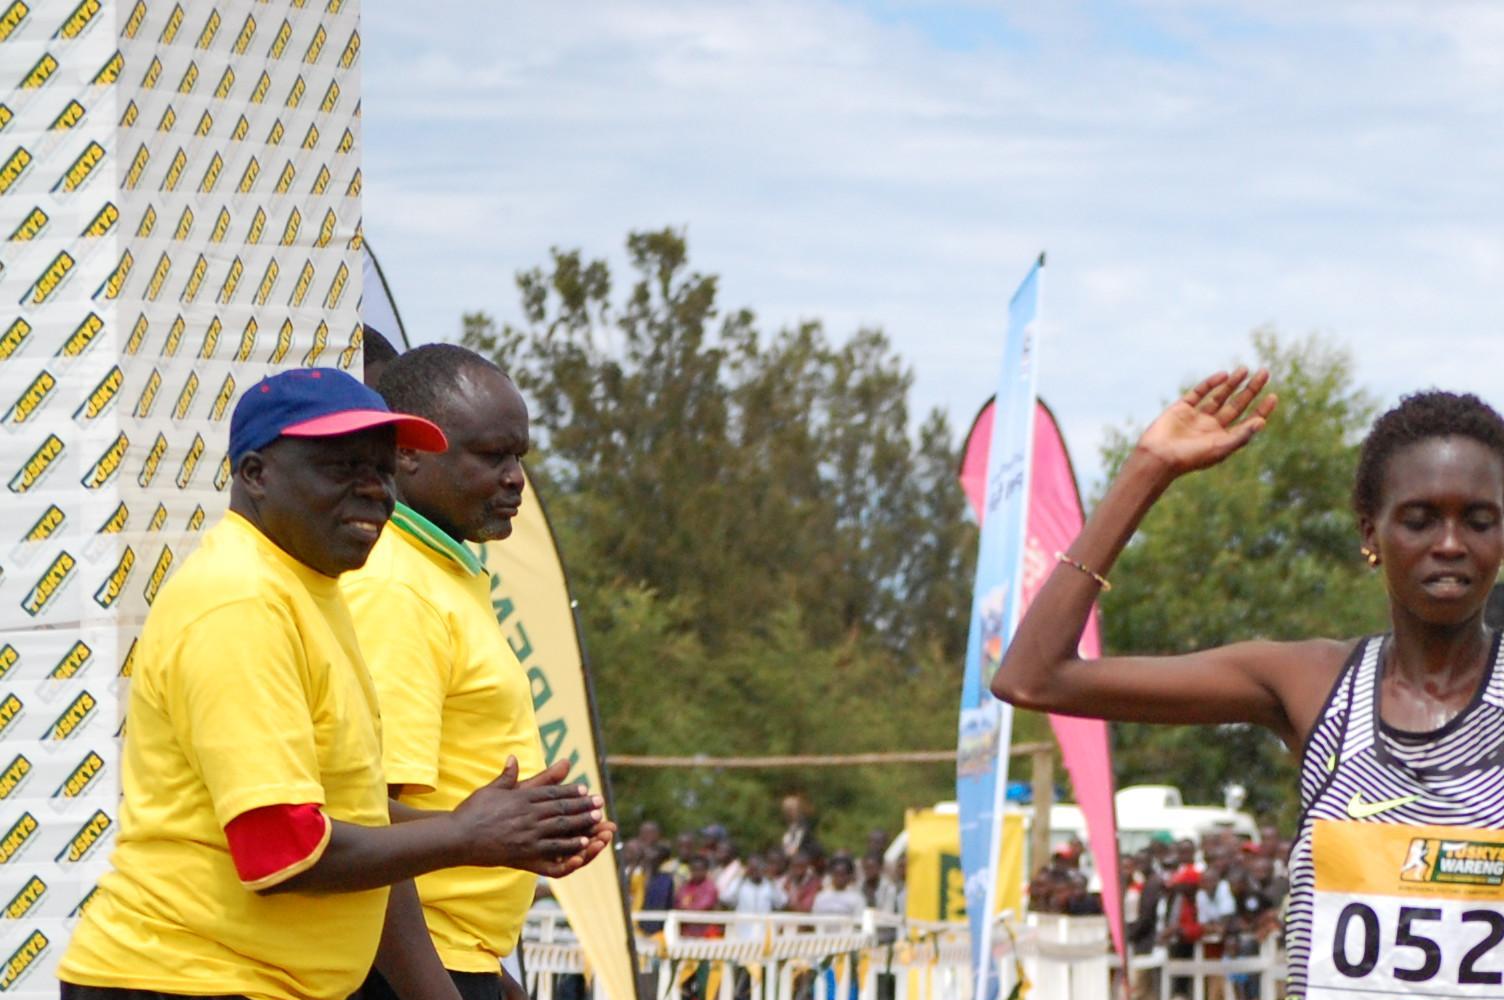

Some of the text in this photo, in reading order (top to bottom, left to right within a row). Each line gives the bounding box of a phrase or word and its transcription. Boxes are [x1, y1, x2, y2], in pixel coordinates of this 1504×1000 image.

[64, 0, 100, 38] SKYS
[0, 149, 30, 194] SKYS
[65, 145, 104, 190] USKYS
[35, 254, 74, 303] USKYS
[65, 315, 102, 356] SKYS
[16, 373, 55, 422] USKYS
[87, 371, 123, 417] USKYS
[53, 643, 91, 679] SKYS
[55, 692, 95, 739] USKYS
[0, 757, 30, 799] SKYS
[64, 754, 103, 798] SKYS
[0, 815, 38, 863] USKYS
[69, 812, 109, 862] USKYS
[1439, 857, 1504, 876] WARENG
[6, 879, 46, 919] SKYS
